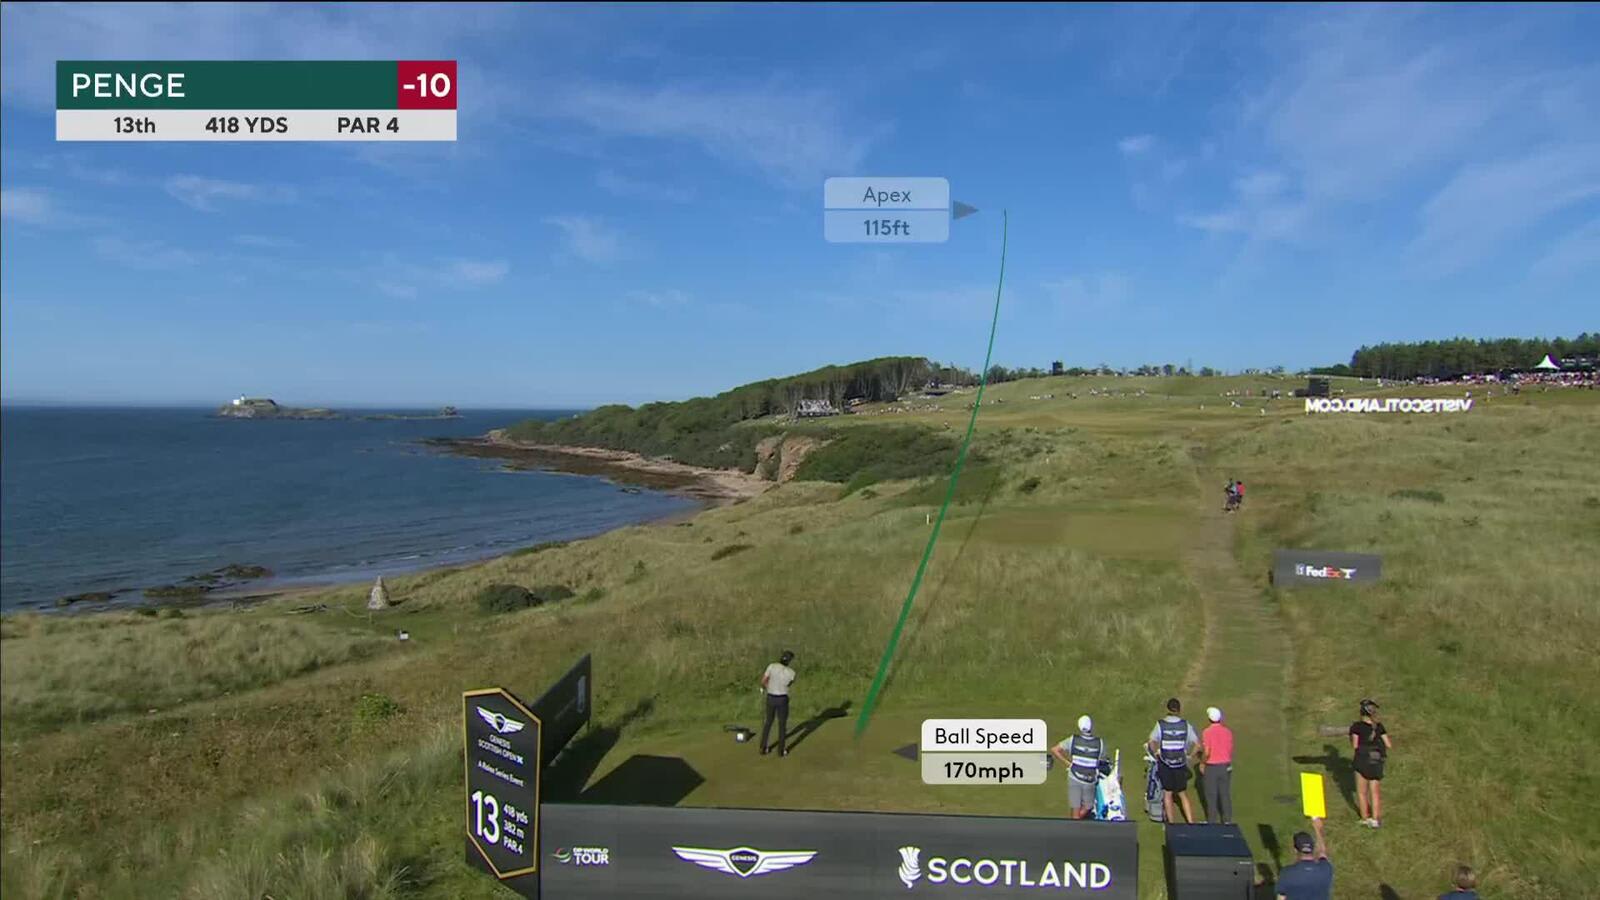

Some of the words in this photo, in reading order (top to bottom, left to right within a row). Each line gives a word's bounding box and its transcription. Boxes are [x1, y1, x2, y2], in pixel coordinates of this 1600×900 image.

[1306, 565, 1341, 578] FedEx
[471, 790, 500, 845] 13
[503, 803, 515, 817] 418
[516, 811, 529, 825] yds
[503, 820, 516, 836] 382
[516, 828, 525, 839] m
[503, 836, 517, 852] PAR
[574, 853, 609, 865] TOUR
[927, 857, 1112, 890] SCOTLAND
